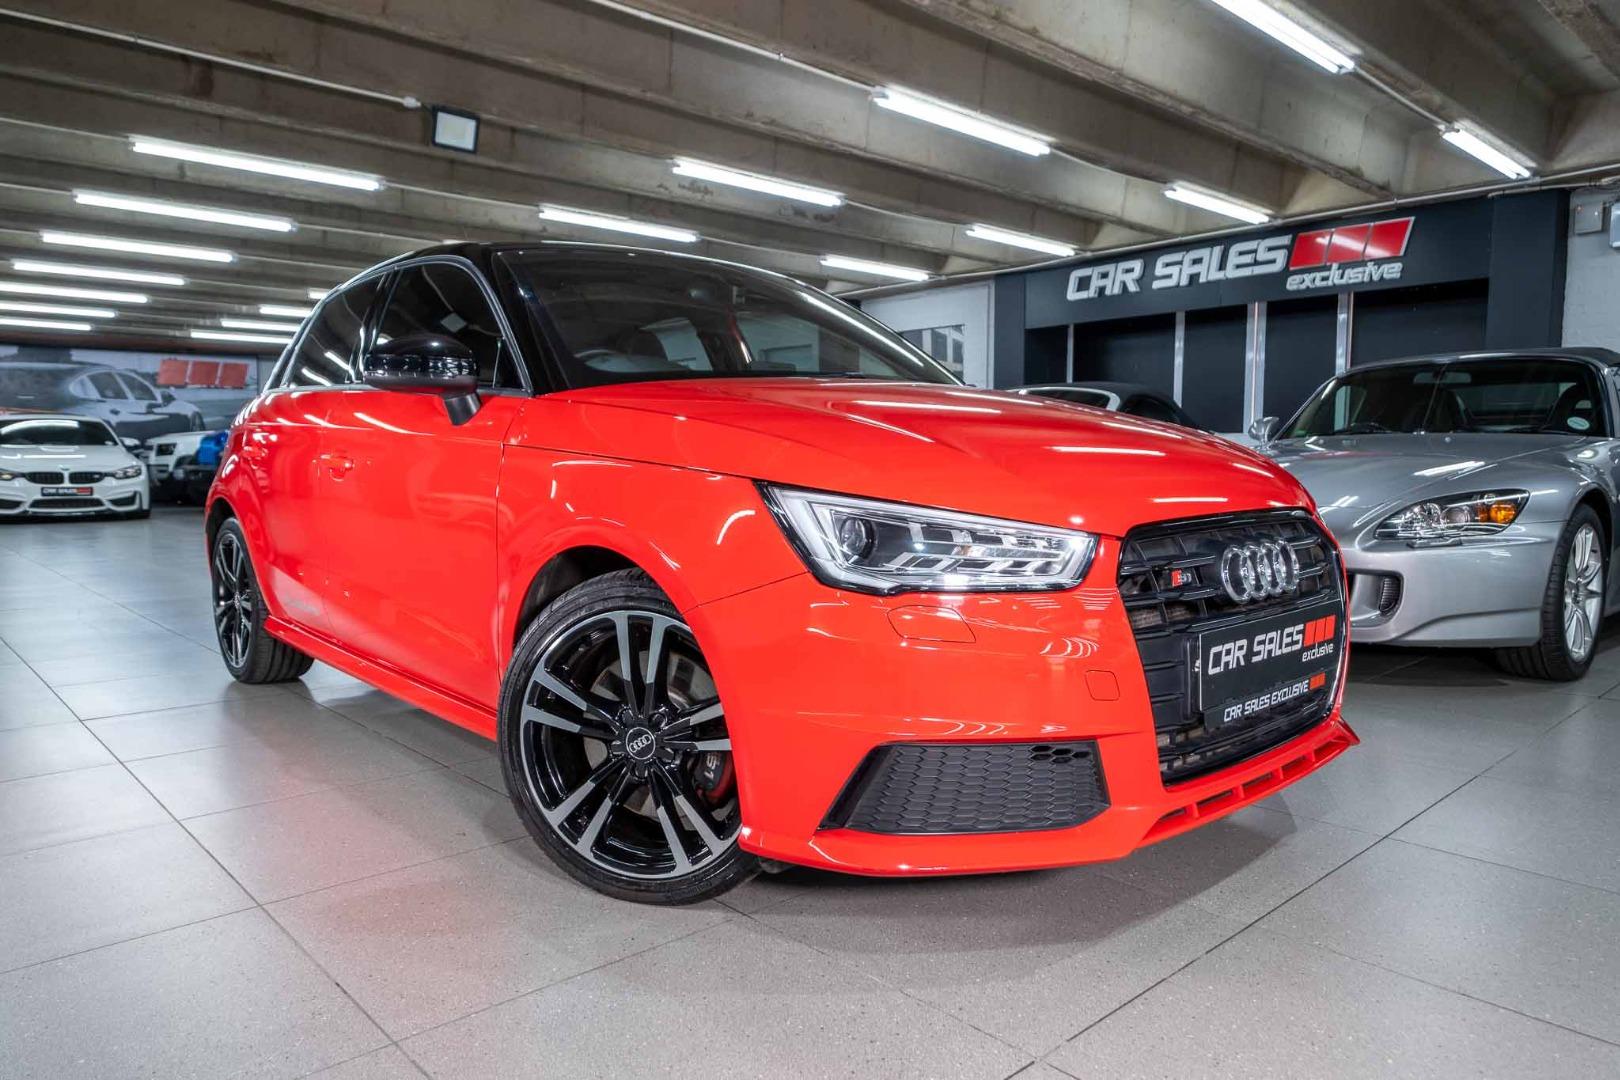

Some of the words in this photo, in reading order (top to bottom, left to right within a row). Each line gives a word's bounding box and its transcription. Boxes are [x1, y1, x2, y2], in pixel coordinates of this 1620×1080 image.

[1066, 258, 1145, 301] CAR
[1151, 234, 1293, 290] SALES
[1285, 260, 1404, 292] exclusive
[1208, 639, 1248, 675] CAR
[1251, 624, 1304, 663] SALES
[1302, 643, 1334, 662] exclusive
[1223, 703, 1242, 722] CAR
[1244, 694, 1271, 715] SALES
[1271, 680, 1310, 705] EXCLUSIVE
